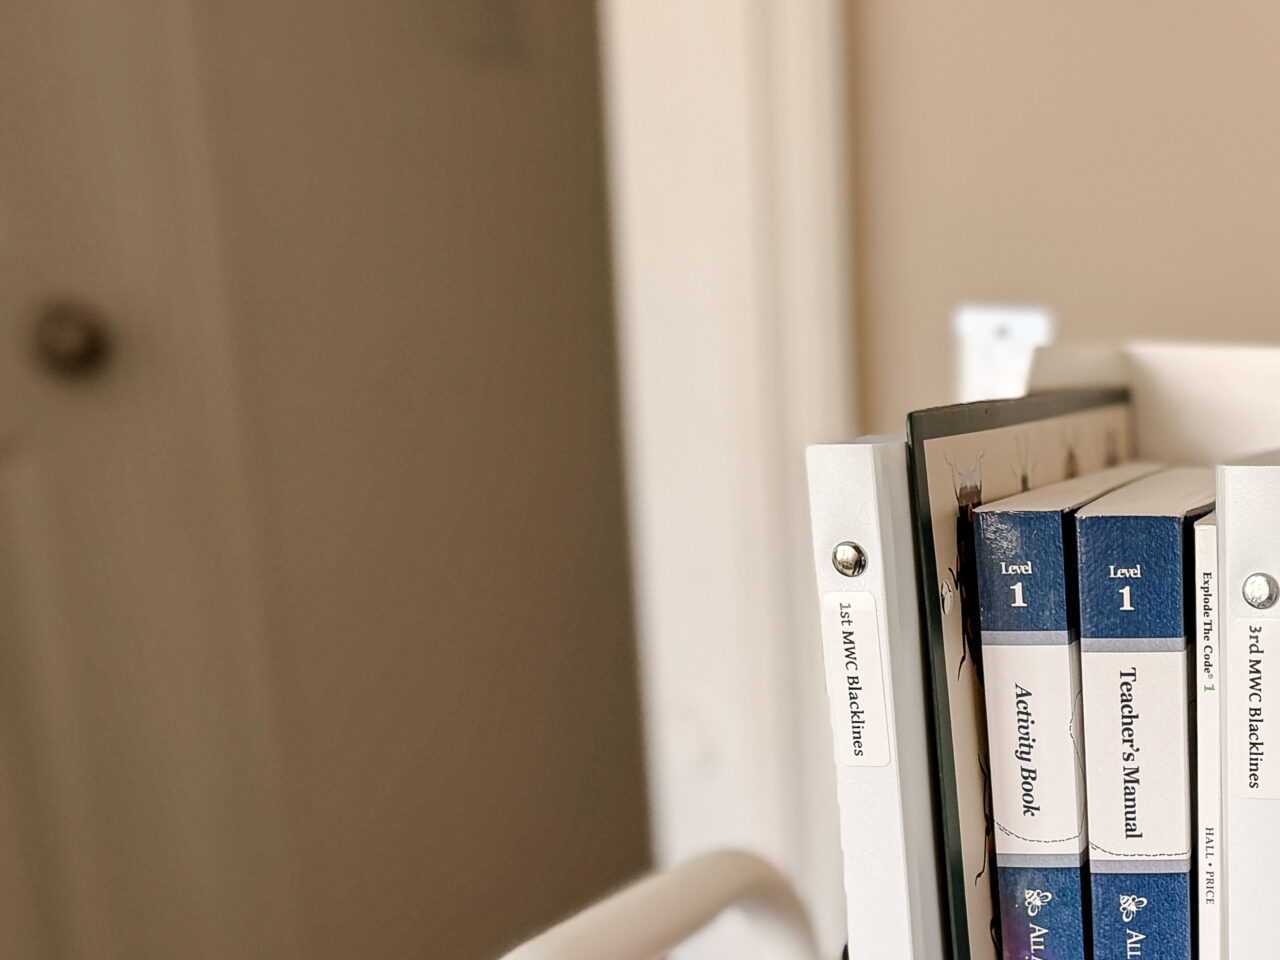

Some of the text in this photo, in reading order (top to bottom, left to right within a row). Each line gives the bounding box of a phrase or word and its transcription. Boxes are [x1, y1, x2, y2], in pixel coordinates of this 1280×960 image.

[1000, 561, 1032, 575] Level
[1109, 564, 1142, 579] Level
[1009, 582, 1027, 607] 1
[1118, 585, 1135, 611] 1
[1200, 572, 1212, 618] Explode
[1203, 619, 1213, 641] The
[839, 602, 865, 757] 1st MWC Blacklines
[1204, 684, 1215, 692] 1
[1248, 625, 1264, 789] 3rd MWC Blacklines
[1015, 682, 1041, 817] Activity Book
[1119, 667, 1143, 840] Teacher's Manual
[1205, 827, 1215, 905] HALL PRICE
[1029, 923, 1049, 953] ALL
[1126, 928, 1146, 959] ALL
